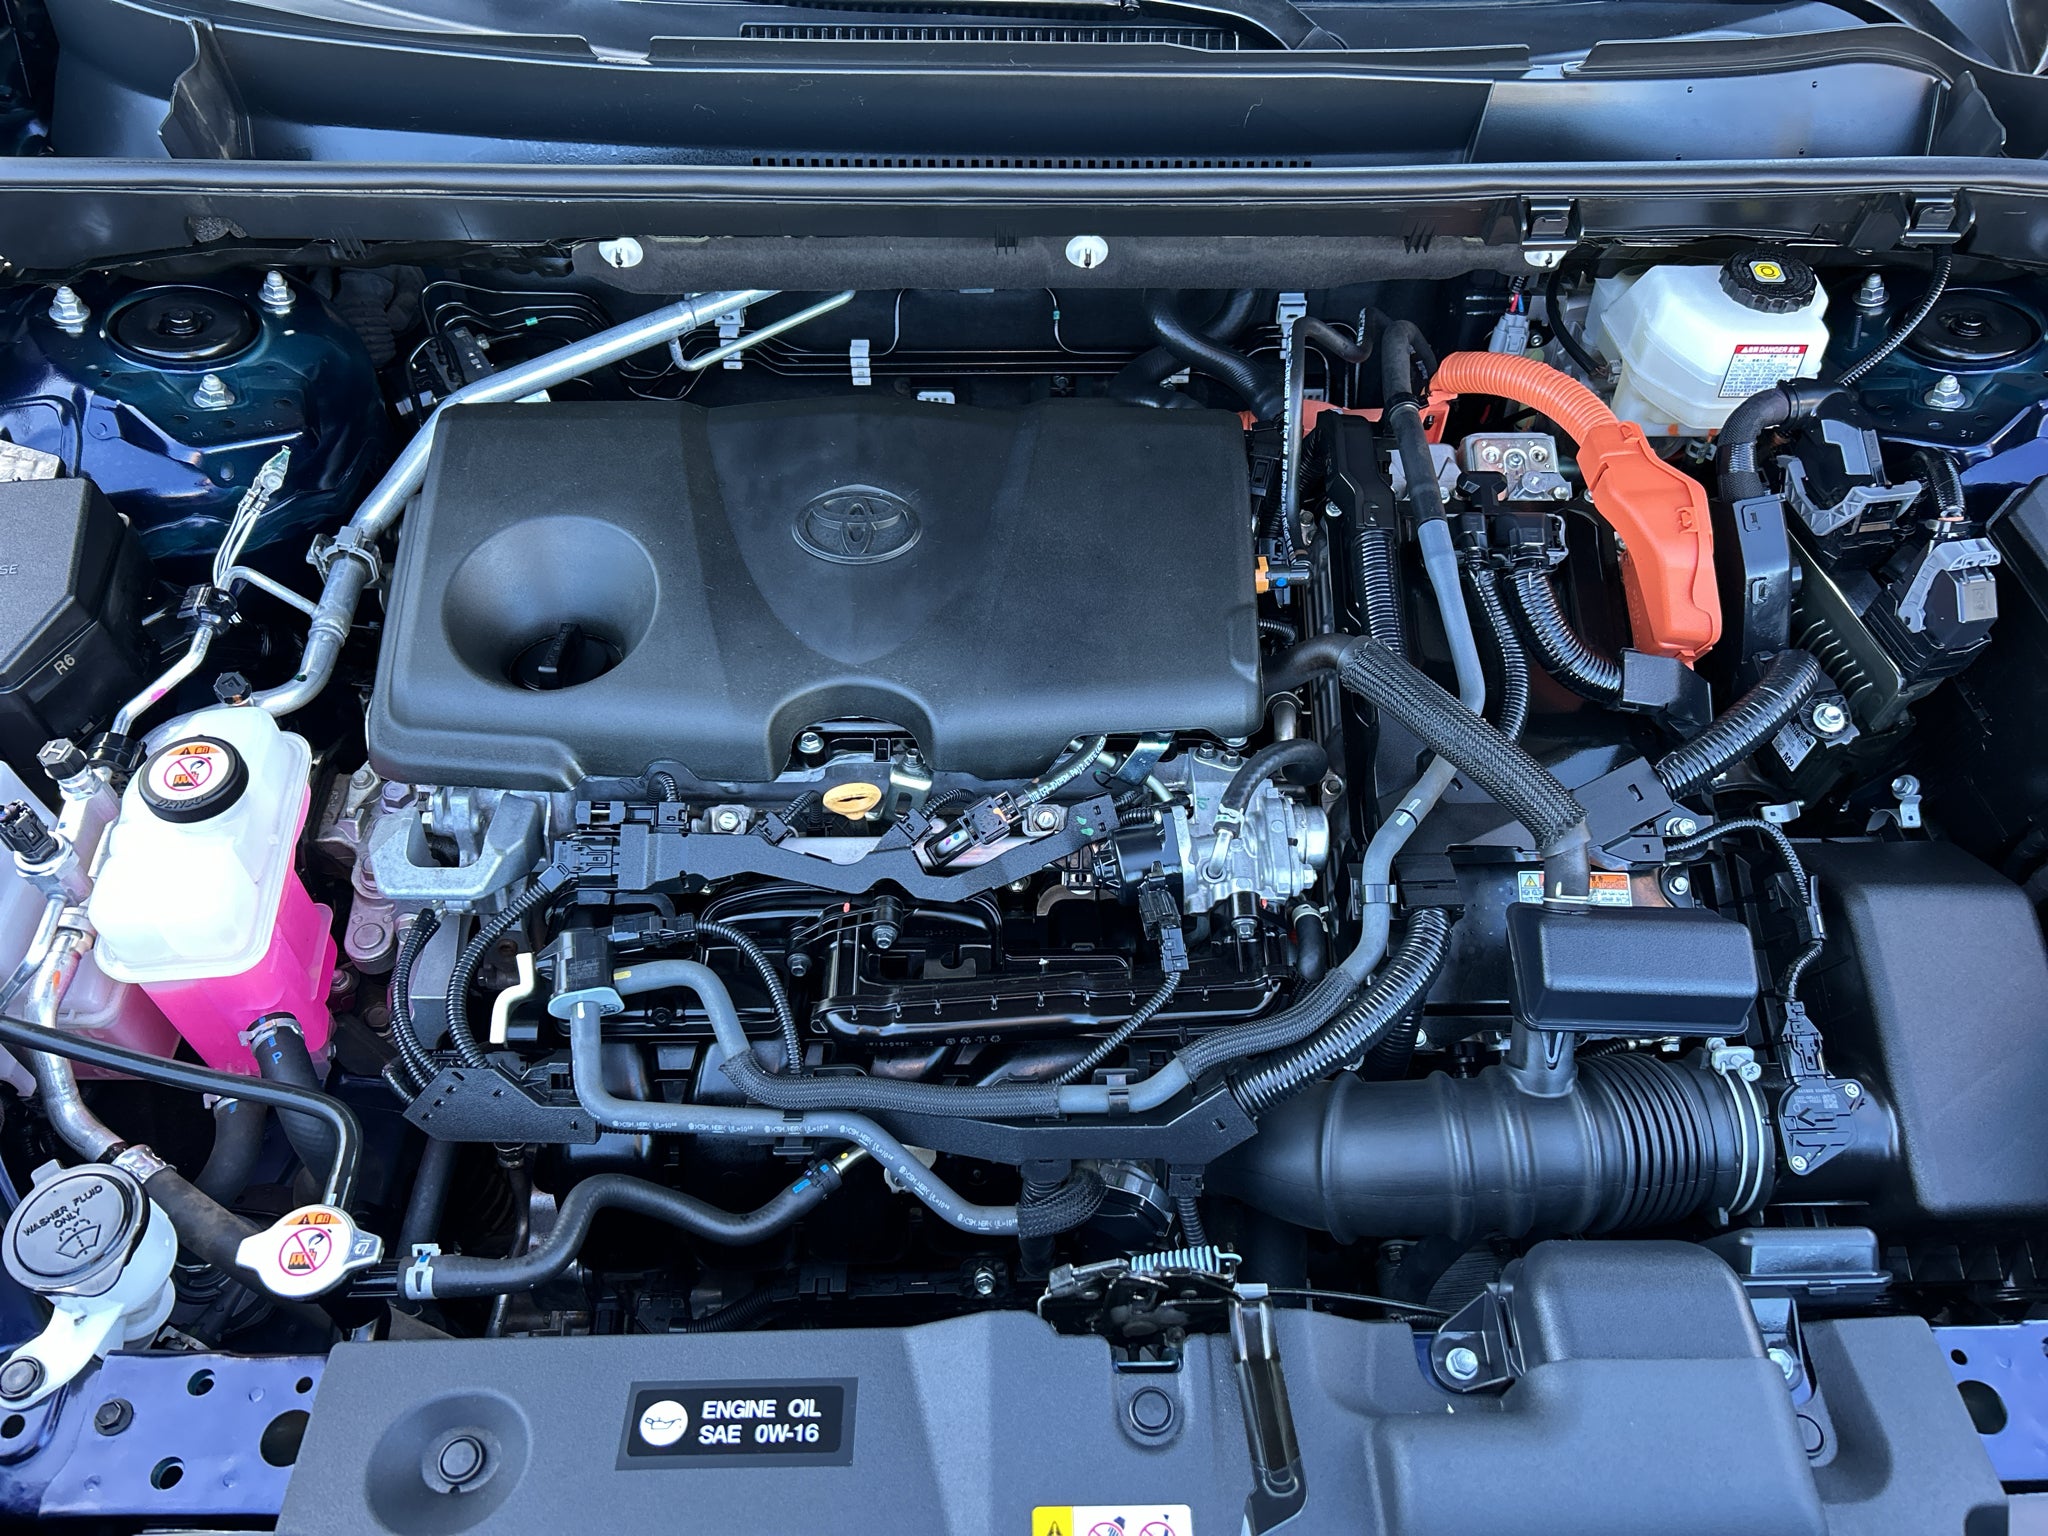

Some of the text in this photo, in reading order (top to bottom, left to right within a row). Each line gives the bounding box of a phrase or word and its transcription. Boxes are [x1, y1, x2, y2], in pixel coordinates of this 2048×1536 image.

[53, 653, 75, 676] R6
[42, 741, 71, 761] H
[1782, 751, 1795, 767] M9
[272, 1051, 283, 1064] P
[22, 1185, 103, 1237] WASHER FLUID
[53, 1207, 80, 1229] ONLY
[701, 1398, 822, 1420] ENGINE OIL
[698, 1423, 820, 1444] SAE 0W-16
